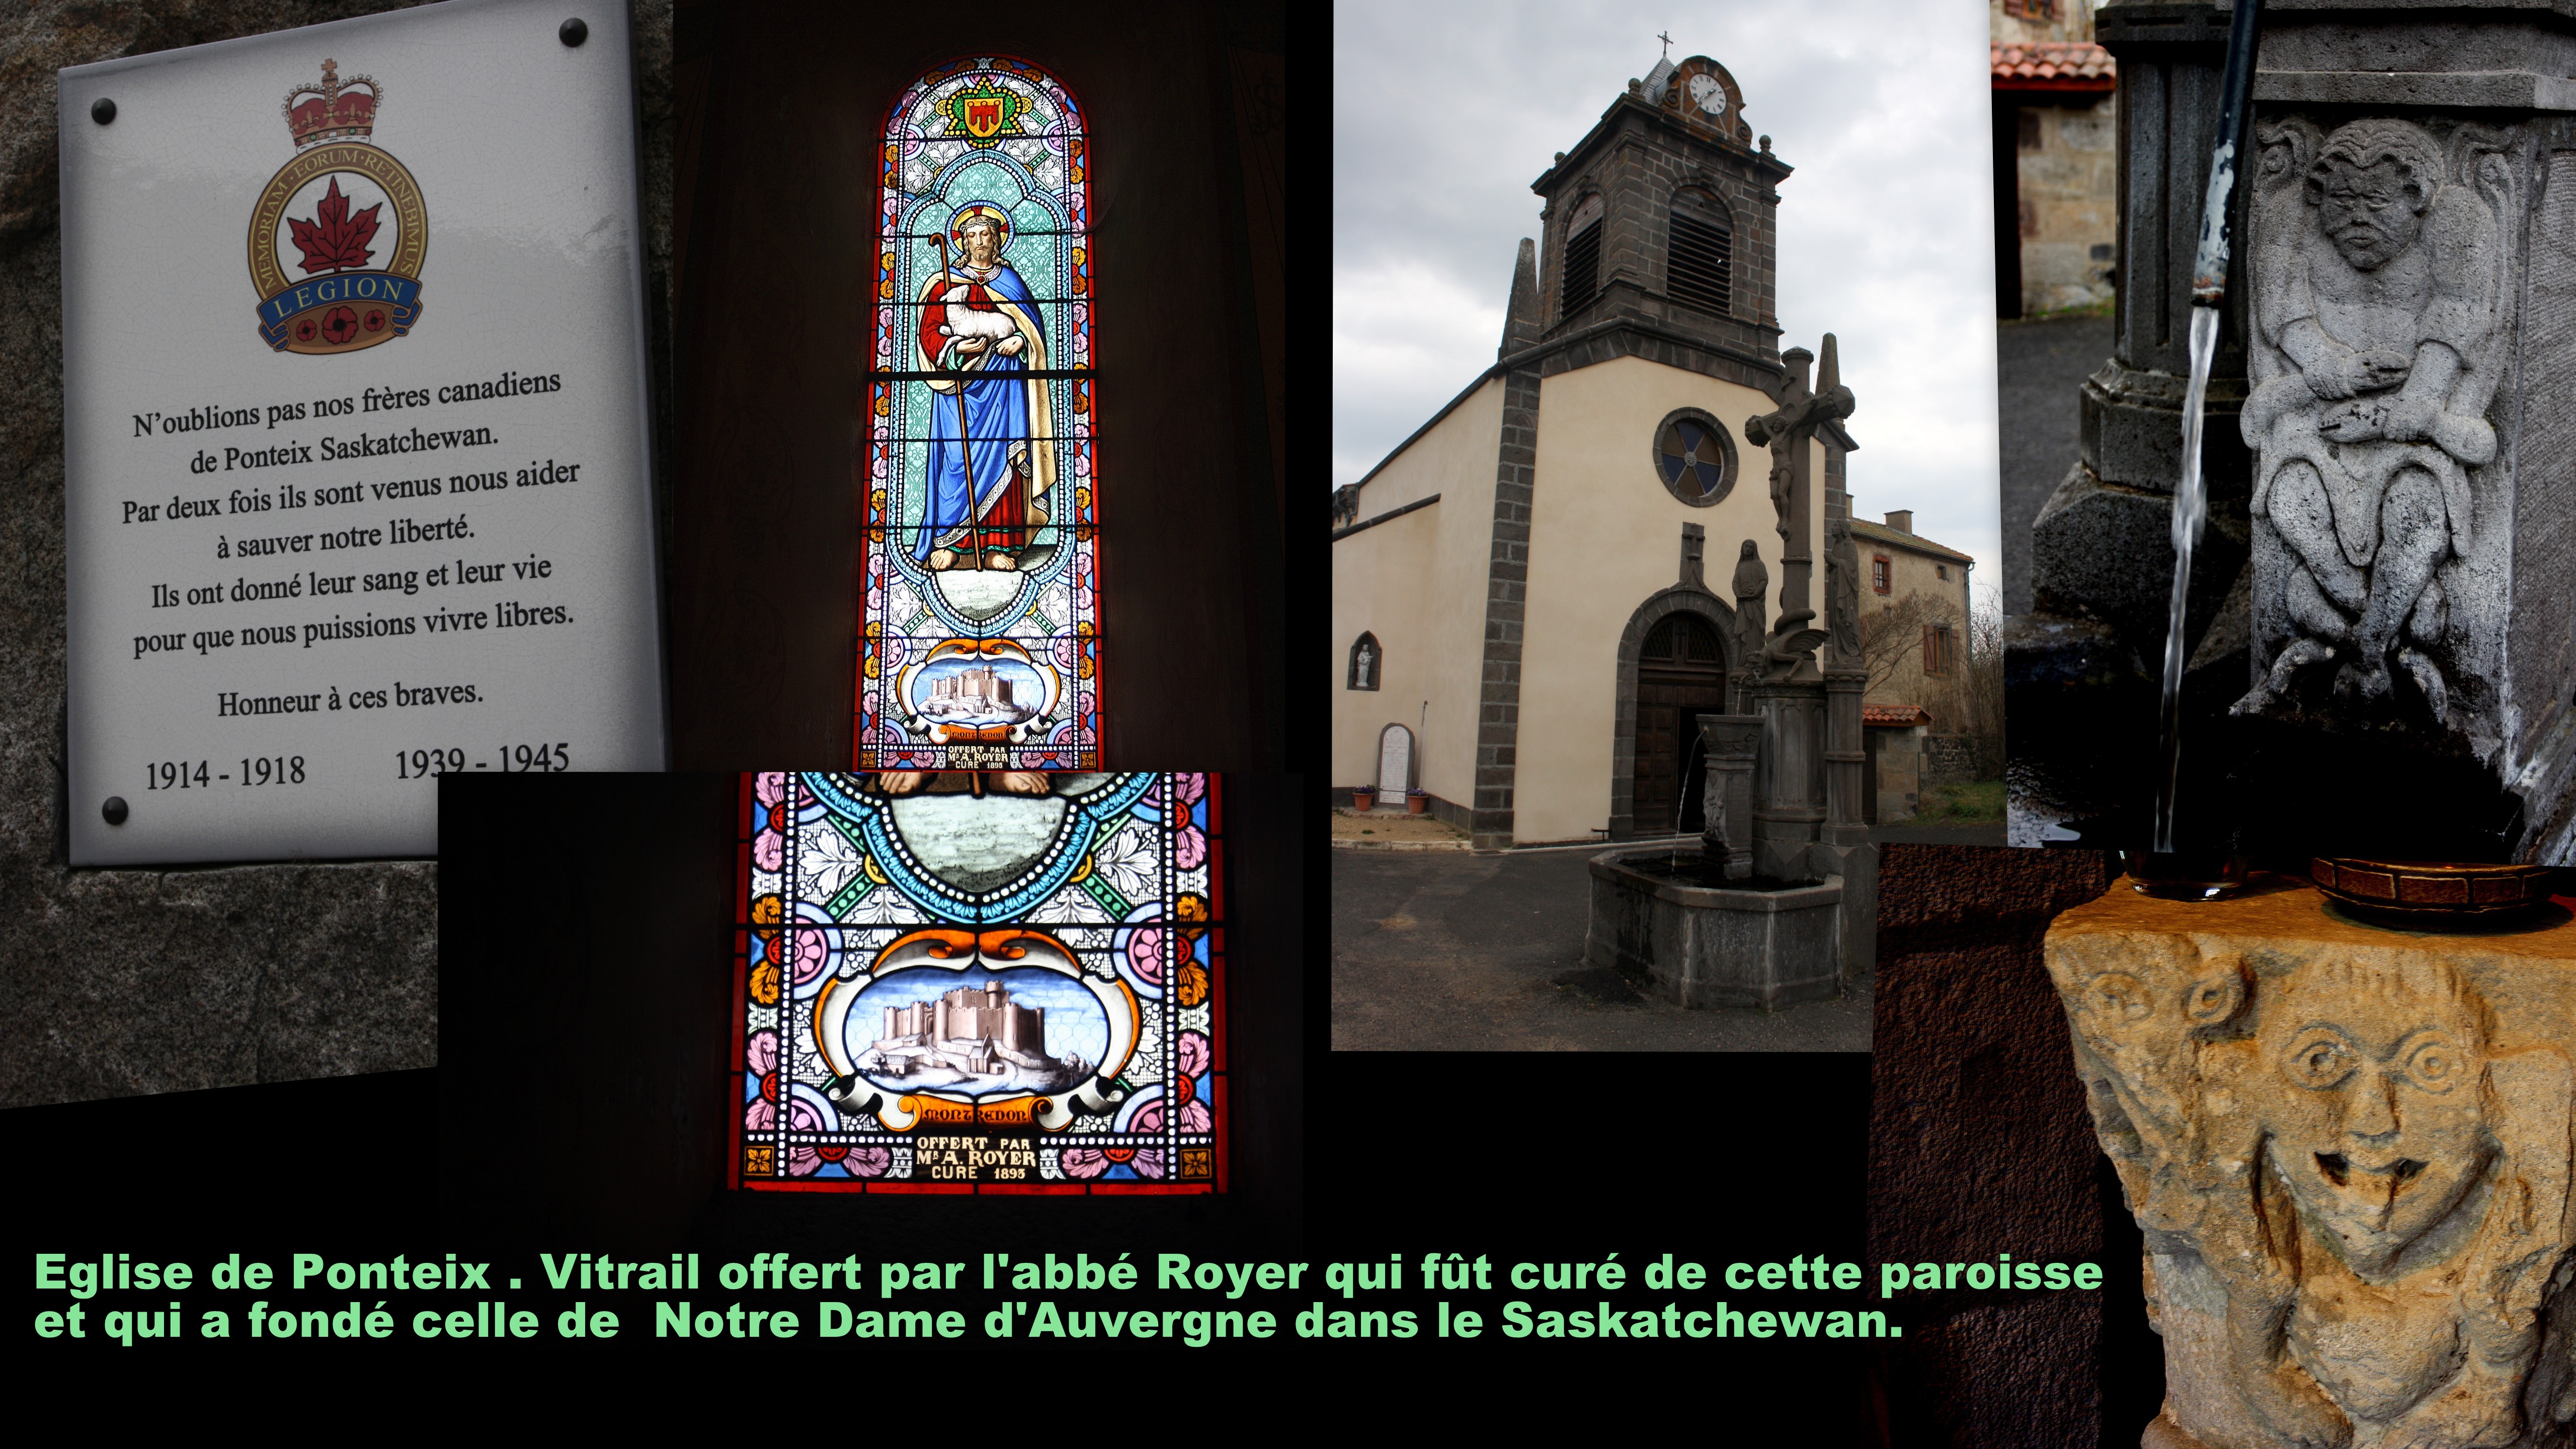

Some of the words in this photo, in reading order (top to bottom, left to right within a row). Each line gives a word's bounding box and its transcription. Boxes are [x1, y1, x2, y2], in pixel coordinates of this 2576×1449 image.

[257, 182, 289, 290] MEMORIAM
[294, 150, 358, 179] EORUM
[364, 153, 419, 274] RETINEBIMUS
[273, 277, 405, 319] LEGION
[267, 403, 305, 429] pas
[313, 397, 354, 417] nos
[362, 386, 430, 412] frères
[439, 371, 560, 404] canadiens
[191, 450, 217, 473] de
[224, 440, 313, 470] Ponteix
[321, 428, 498, 461] Saskatchewan.
[122, 501, 160, 523] Par
[167, 496, 221, 519] deux
[229, 488, 271, 514] fois
[279, 485, 306, 509] ils
[315, 481, 364, 506] sont
[371, 478, 441, 500] venus
[449, 471, 508, 493] nous
[517, 459, 580, 487] aider
[218, 536, 230, 558] à
[238, 535, 313, 557] sauver
[320, 527, 381, 550] notre
[389, 514, 474, 544] liberté.
[152, 584, 179, 608] Ils
[187, 583, 223, 605] ont
[231, 574, 301, 602] donné
[309, 572, 356, 595] leur
[364, 572, 418, 595] sang
[427, 565, 449, 587] et
[456, 559, 505, 584] leur
[512, 553, 551, 580] vie
[134, 633, 186, 659] pour
[193, 630, 233, 655] que
[241, 626, 296, 645] nous
[303, 613, 415, 648] puissions
[423, 607, 487, 632] vivre
[496, 602, 573, 627] libres.
[218, 693, 321, 716] Honneur
[329, 686, 342, 710] à
[349, 691, 387, 709] ces
[394, 682, 482, 706] braves.
[396, 748, 465, 779] 1939
[500, 743, 569, 772] 1945
[948, 746, 984, 754] OFFERT
[956, 761, 979, 769] CURE
[974, 753, 1008, 762] ROYER
[147, 760, 210, 789] 1914
[242, 756, 305, 785] 1918
[917, 1137, 988, 1151] OFFERT
[1000, 1139, 1030, 1150] PAR
[969, 1151, 1036, 1167] ROYER
[932, 1166, 978, 1179] CURE
